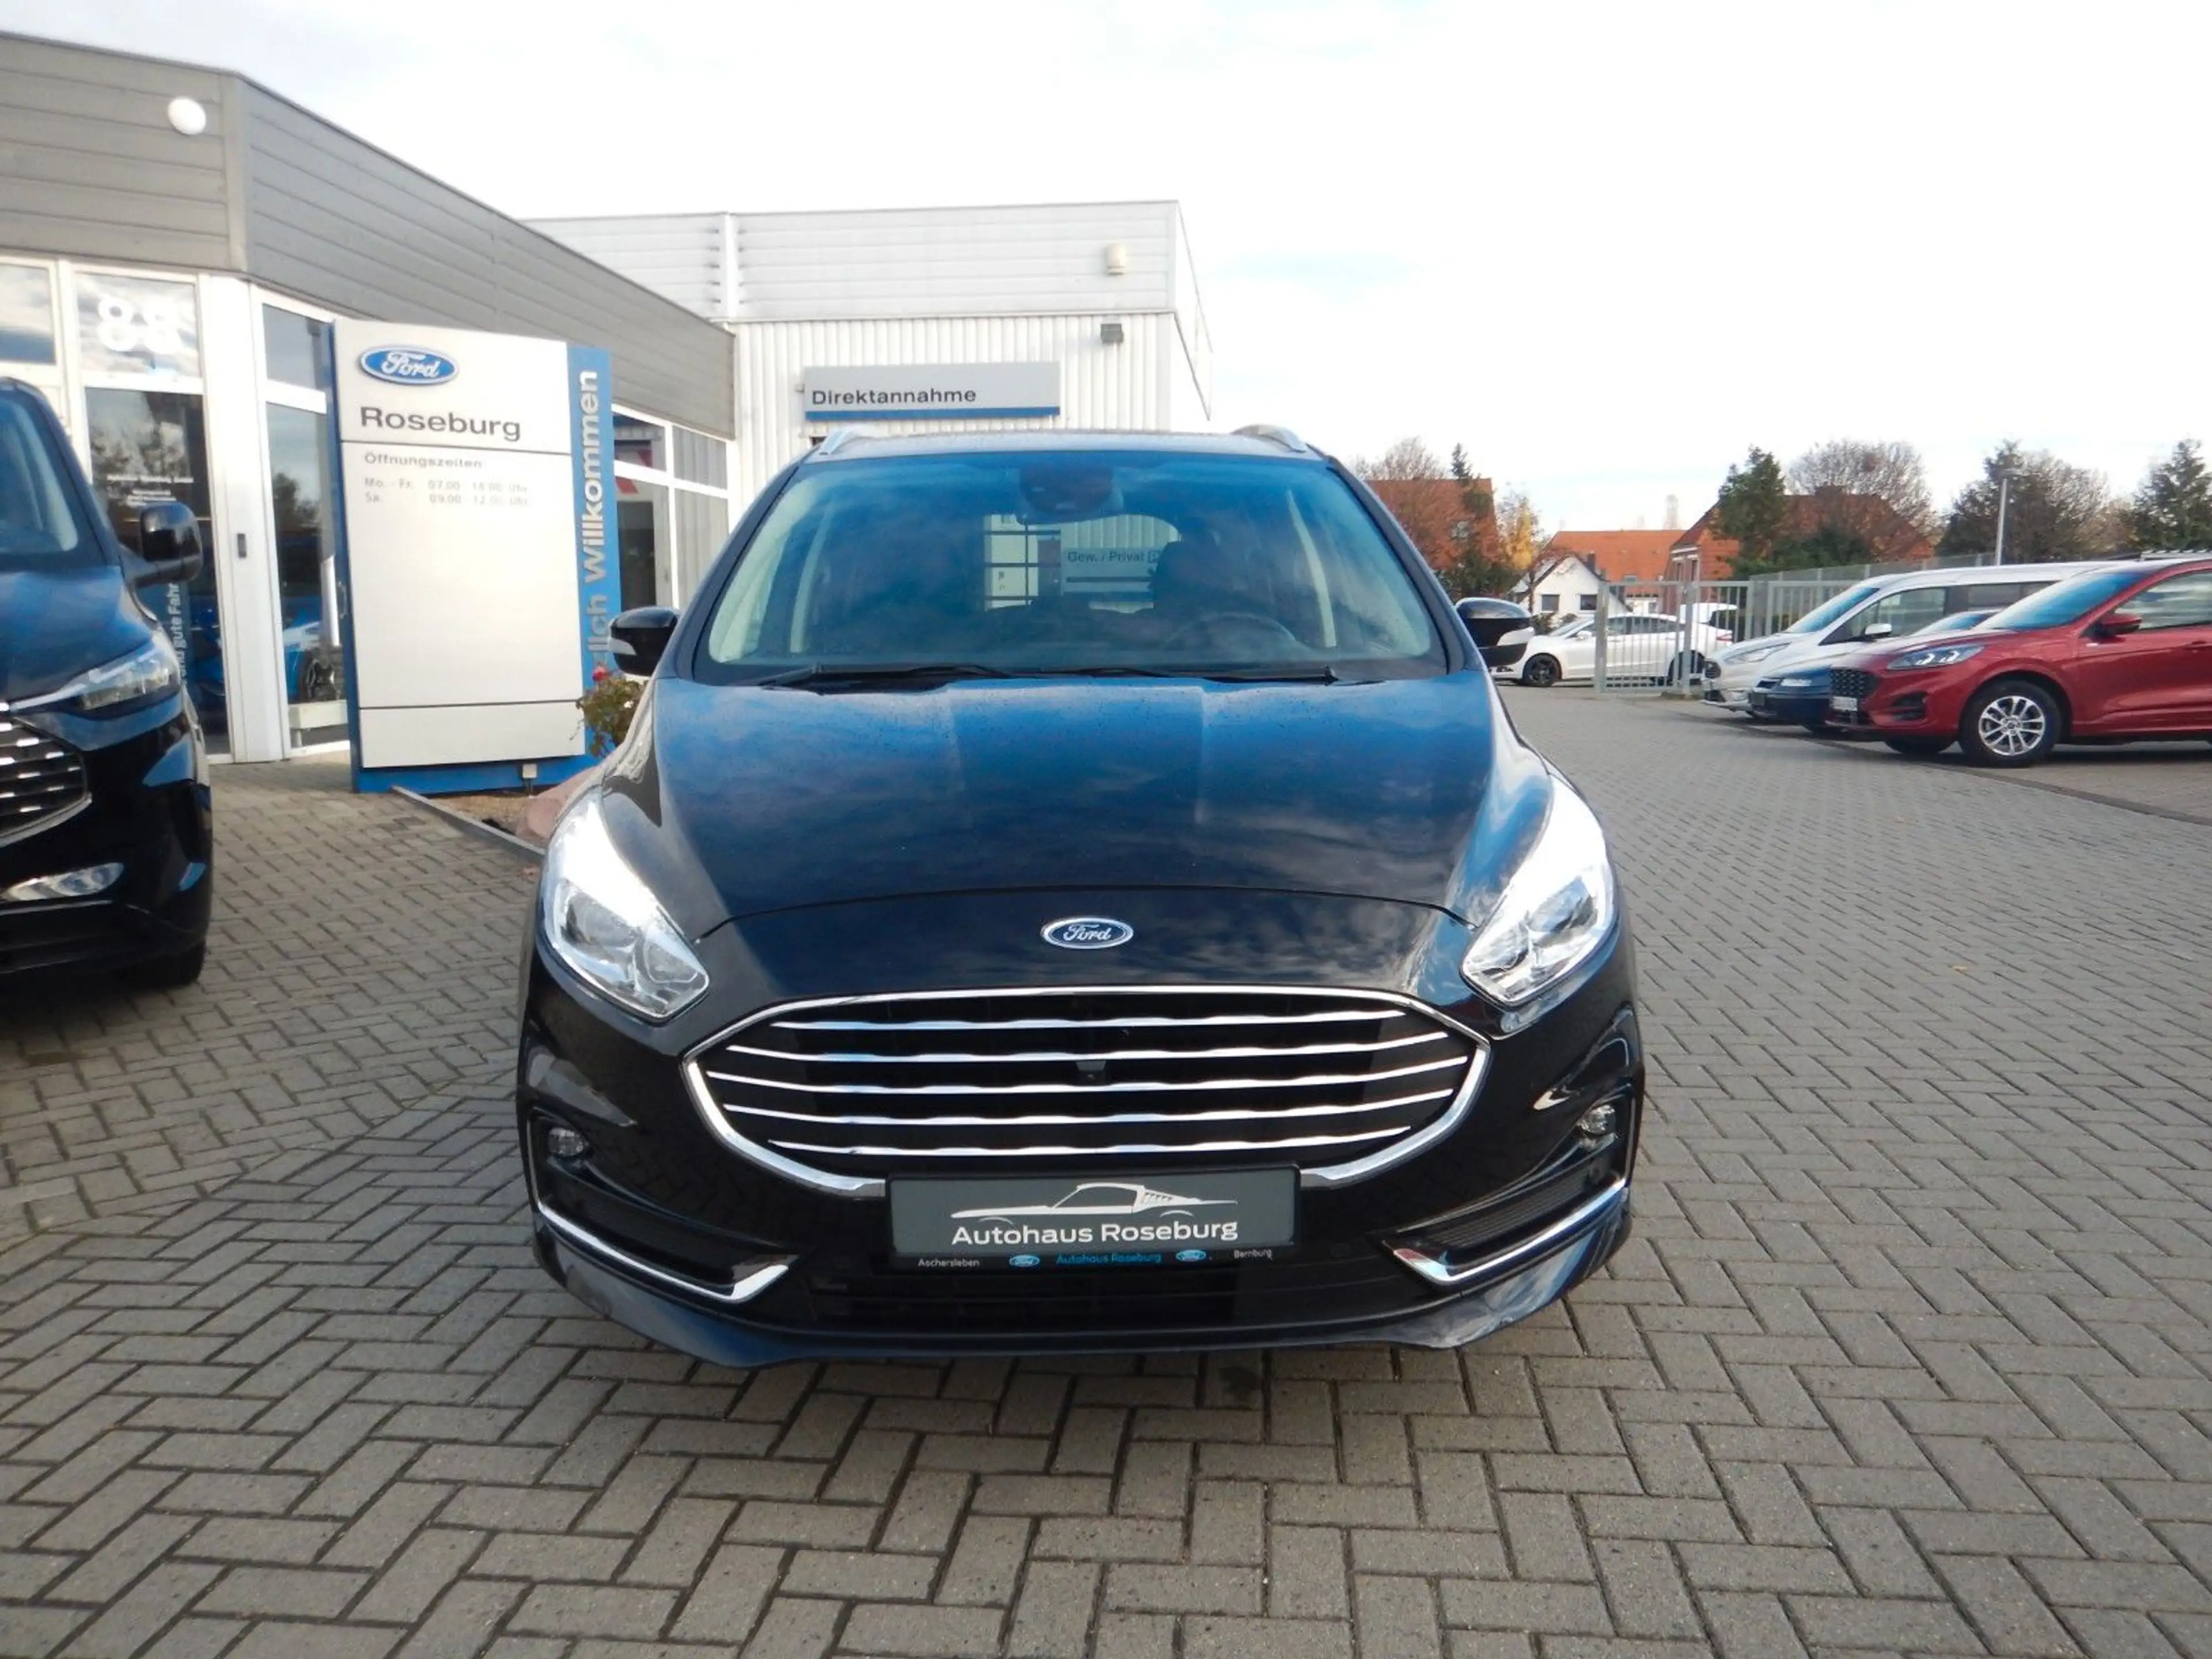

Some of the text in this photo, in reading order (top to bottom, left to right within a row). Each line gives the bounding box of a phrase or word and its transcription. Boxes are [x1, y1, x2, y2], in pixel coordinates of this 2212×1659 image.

[381, 351, 440, 377] Ford
[812, 388, 976, 405] Direktannahme
[361, 407, 521, 441] Roseburg
[365, 450, 482, 469] Öffnungszeiten
[579, 370, 606, 583] Willkommen
[166, 583, 181, 615] Fahr
[1063, 923, 1112, 941] Ford
[951, 1221, 1238, 1245] Autohaus Roseburg
[918, 1258, 980, 1267] Aschersleben
[1056, 1253, 1109, 1265] Autohaus
[1111, 1252, 1161, 1263] Roseburg
